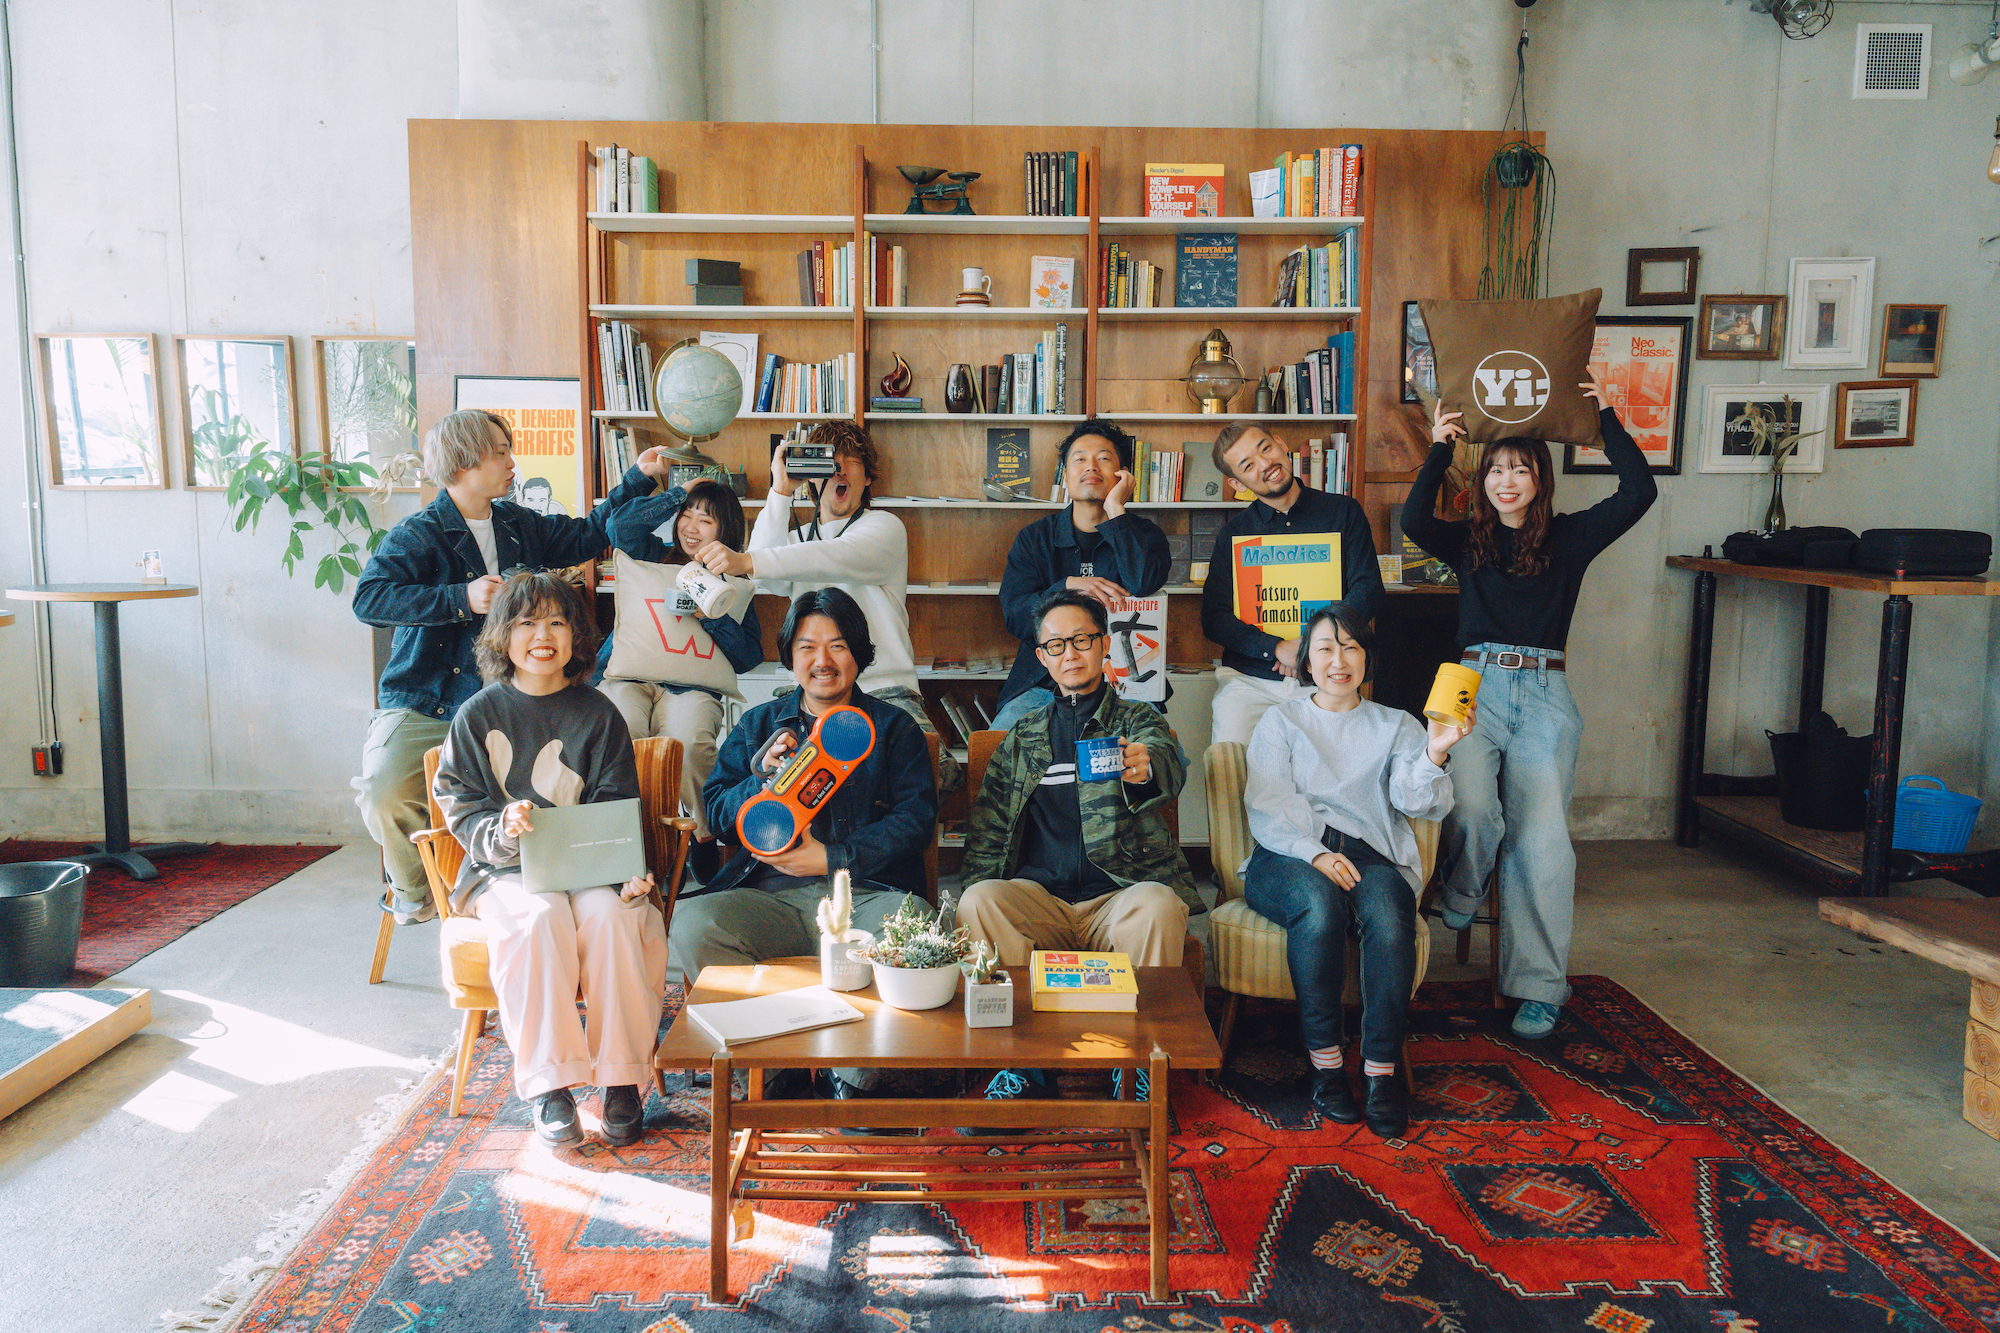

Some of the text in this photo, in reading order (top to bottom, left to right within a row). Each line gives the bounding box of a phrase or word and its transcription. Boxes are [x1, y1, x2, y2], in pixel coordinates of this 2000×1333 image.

[1150, 177, 1170, 185] NEW
[1344, 159, 1356, 205] Webster's
[1149, 185, 1195, 194] COMPLETE
[1150, 202, 1193, 210] YOURSELF
[1632, 337, 1655, 347] Neo
[1630, 347, 1674, 357] Classic.
[522, 409, 575, 428] DENGAN
[512, 430, 574, 456] GRAFIS
[1244, 545, 1329, 564] Melodies
[1255, 585, 1299, 602] Tatsuro
[1090, 755, 1122, 767] COFFE
[800, 773, 812, 786] SONY
[824, 780, 834, 793] Sony
